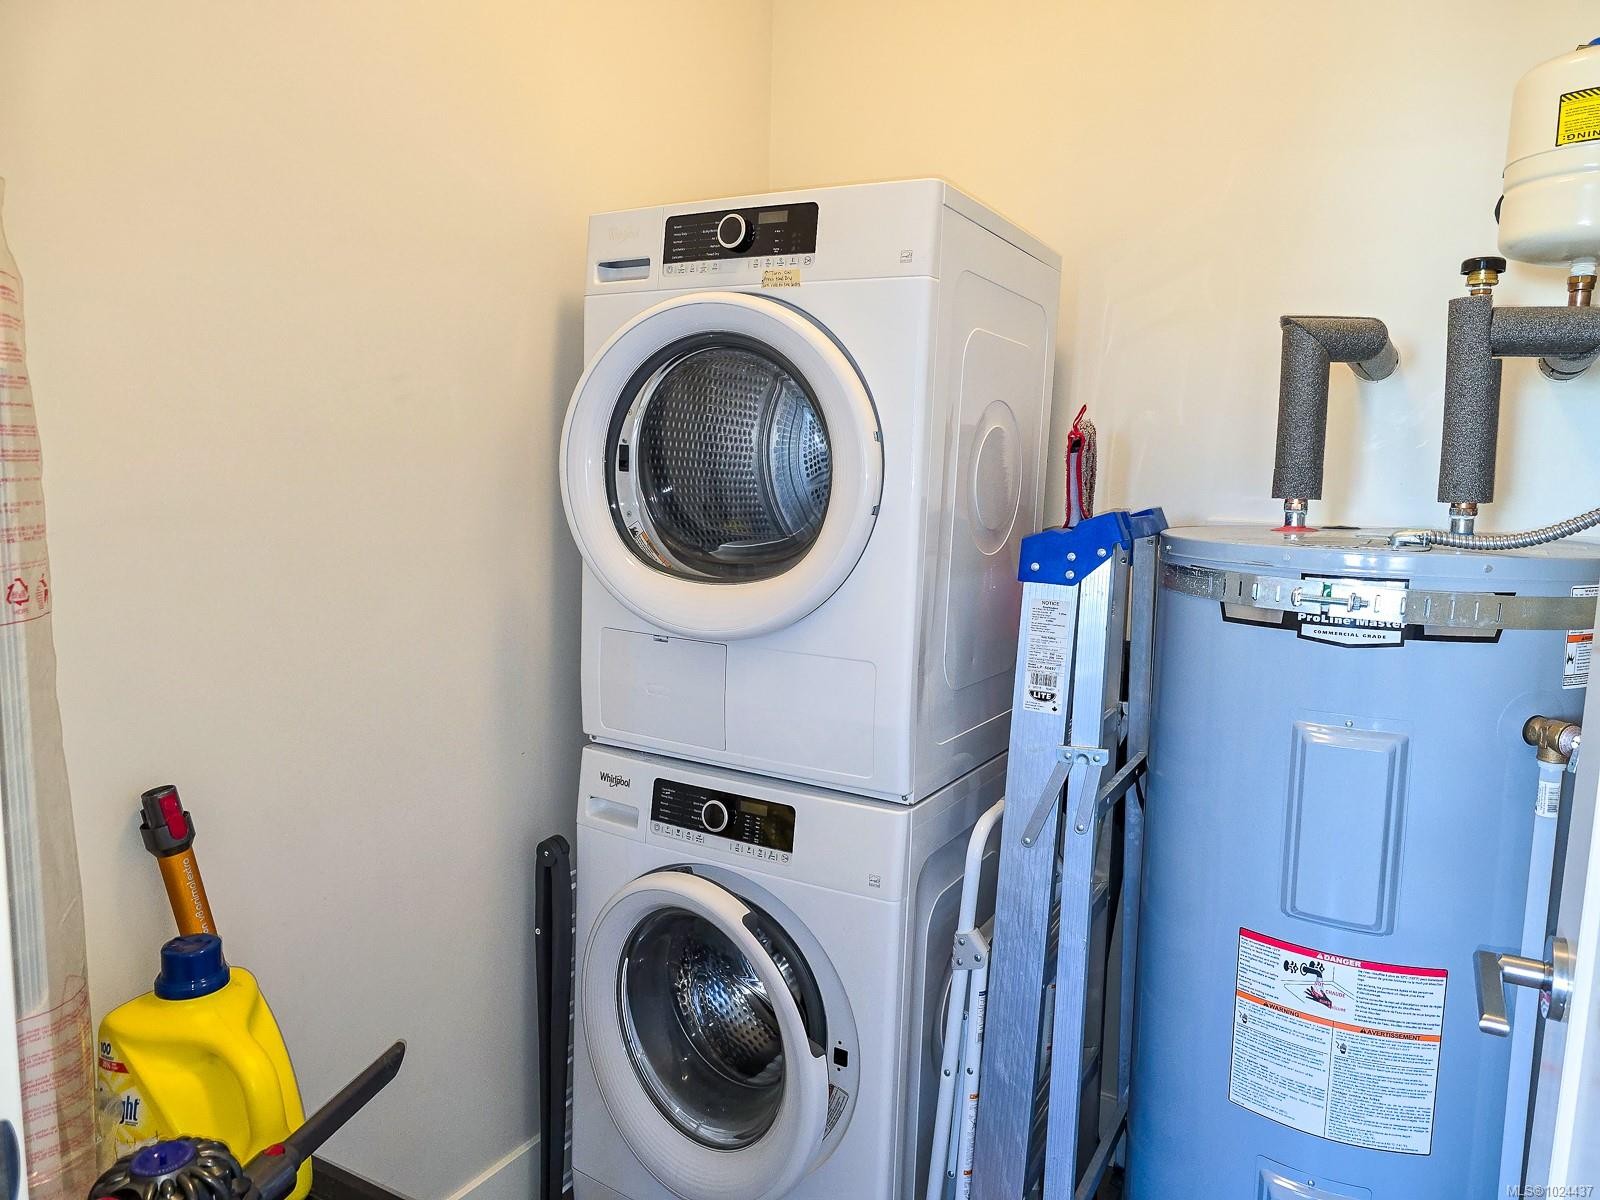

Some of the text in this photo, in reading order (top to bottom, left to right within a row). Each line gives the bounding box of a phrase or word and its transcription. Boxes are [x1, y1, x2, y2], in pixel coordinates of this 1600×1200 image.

[1313, 630, 1358, 638] COMMERCIAL
[1034, 691, 1052, 700] LITE
[600, 771, 630, 788] Whirlpool
[1324, 953, 1361, 968] DANGER
[1326, 990, 1345, 998] CHAUDE
[1268, 1003, 1300, 1018] WARNING
[1366, 1029, 1421, 1041] AVERTISSEMENT
[101, 1042, 111, 1055] 100
